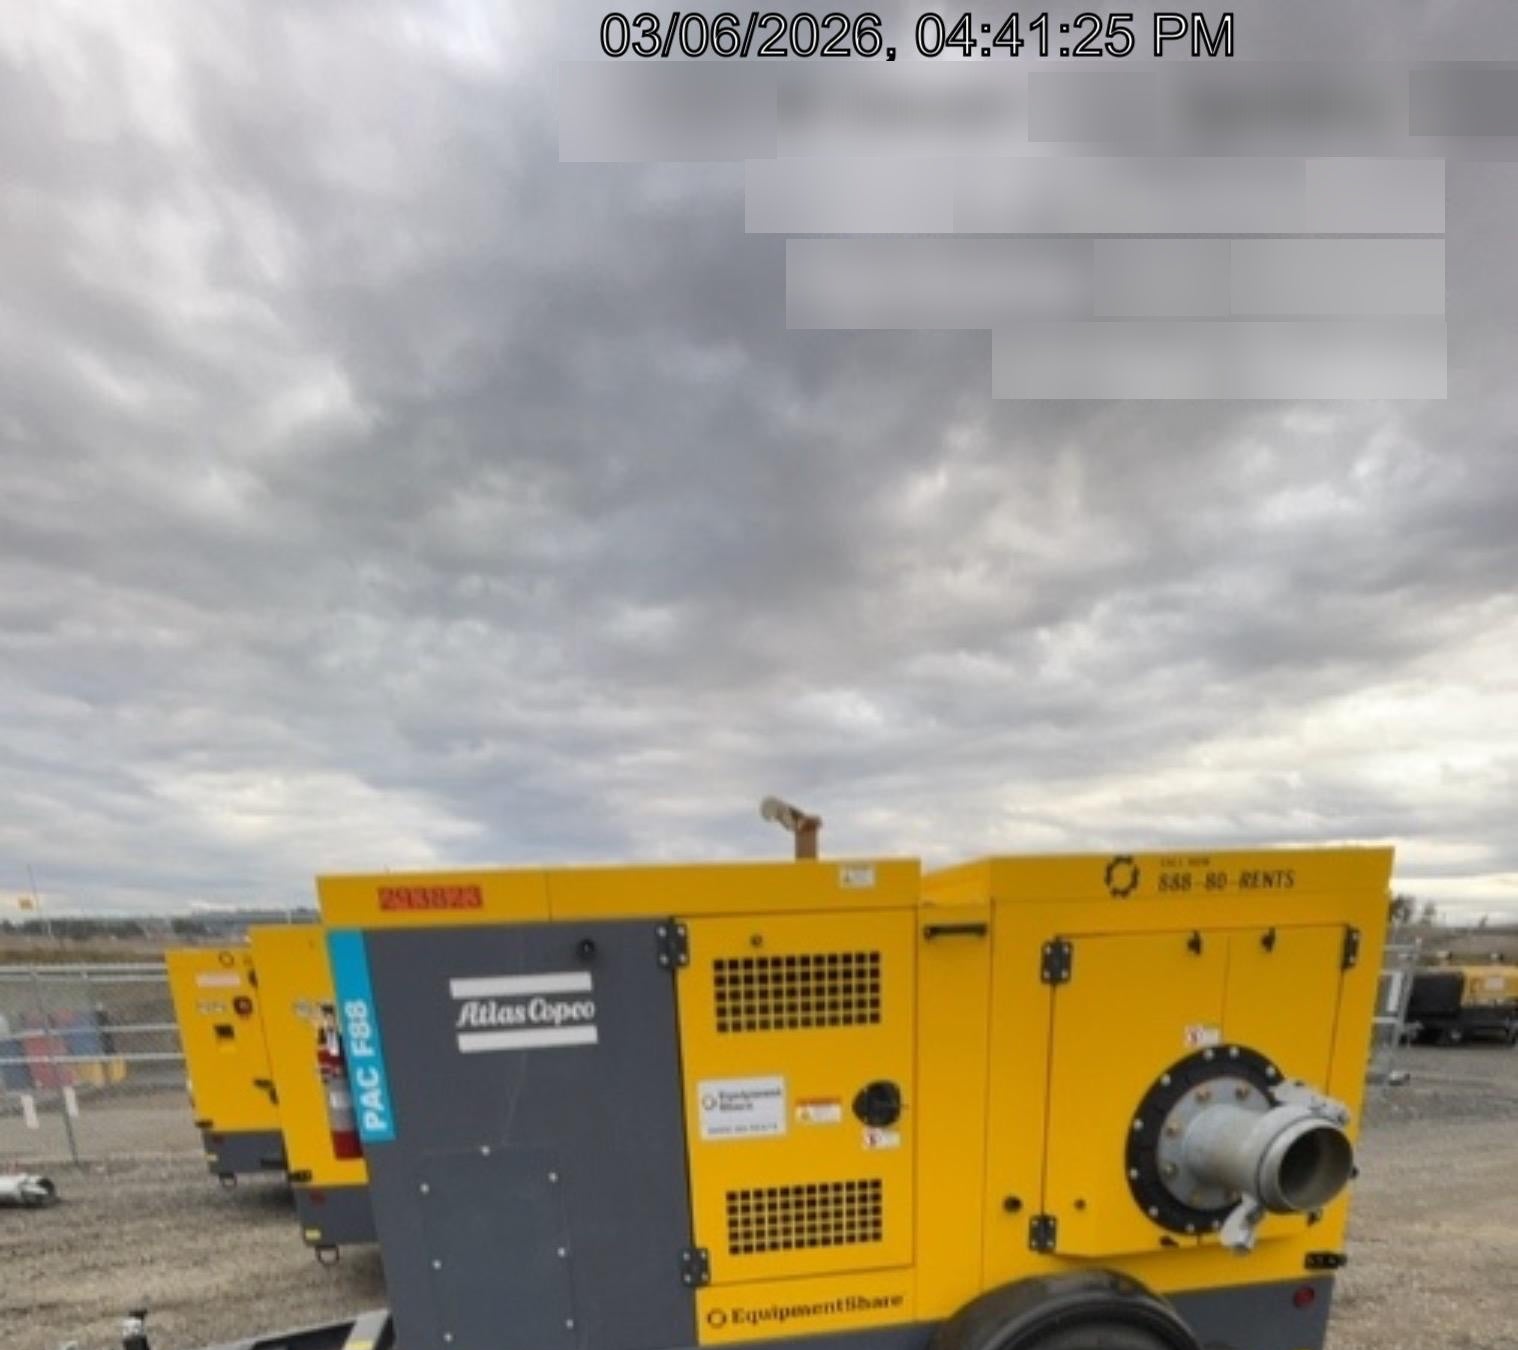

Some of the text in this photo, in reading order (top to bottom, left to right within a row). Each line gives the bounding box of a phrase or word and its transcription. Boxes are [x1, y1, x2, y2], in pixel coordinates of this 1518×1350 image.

[456, 995, 596, 1028] Atlas Copco
[343, 999, 388, 1130] PAC F88
